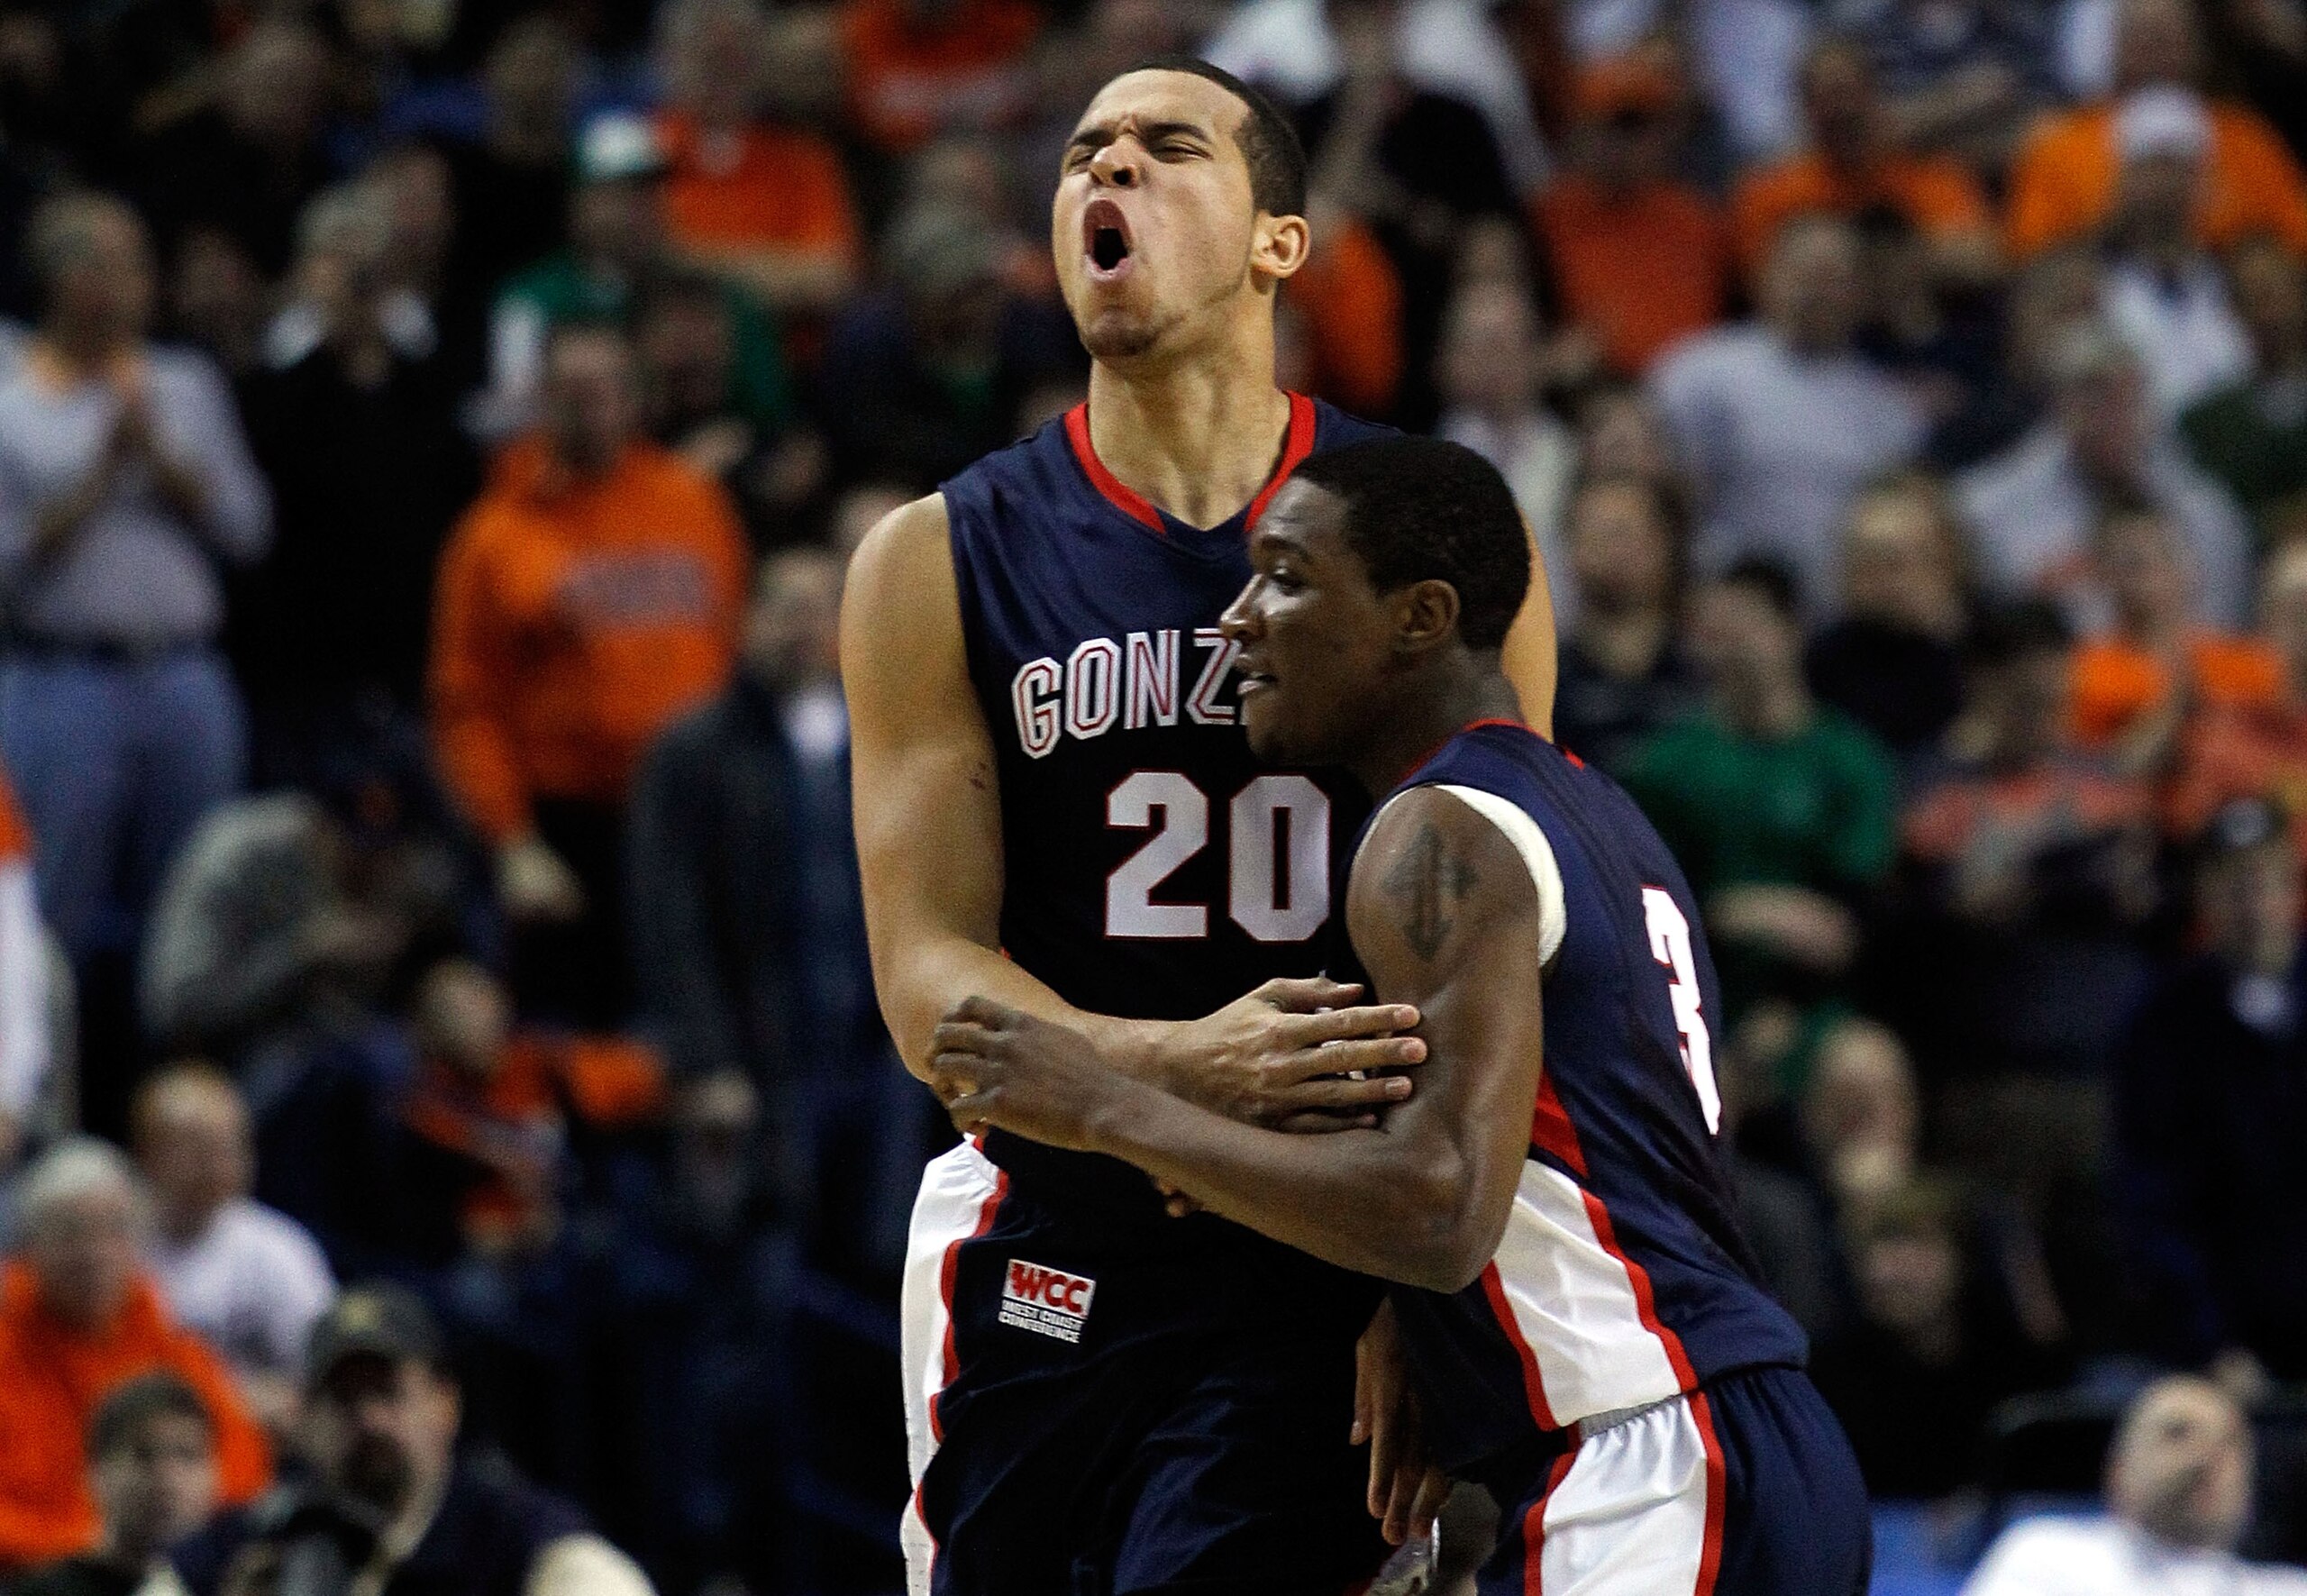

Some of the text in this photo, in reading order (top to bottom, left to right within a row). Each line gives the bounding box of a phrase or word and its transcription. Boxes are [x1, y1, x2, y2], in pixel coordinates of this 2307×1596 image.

[1011, 628, 1248, 760] GONZ
[1104, 769, 1332, 943] 20
[1640, 883, 1722, 1135] 3
[1009, 1263, 1090, 1314] WCC
